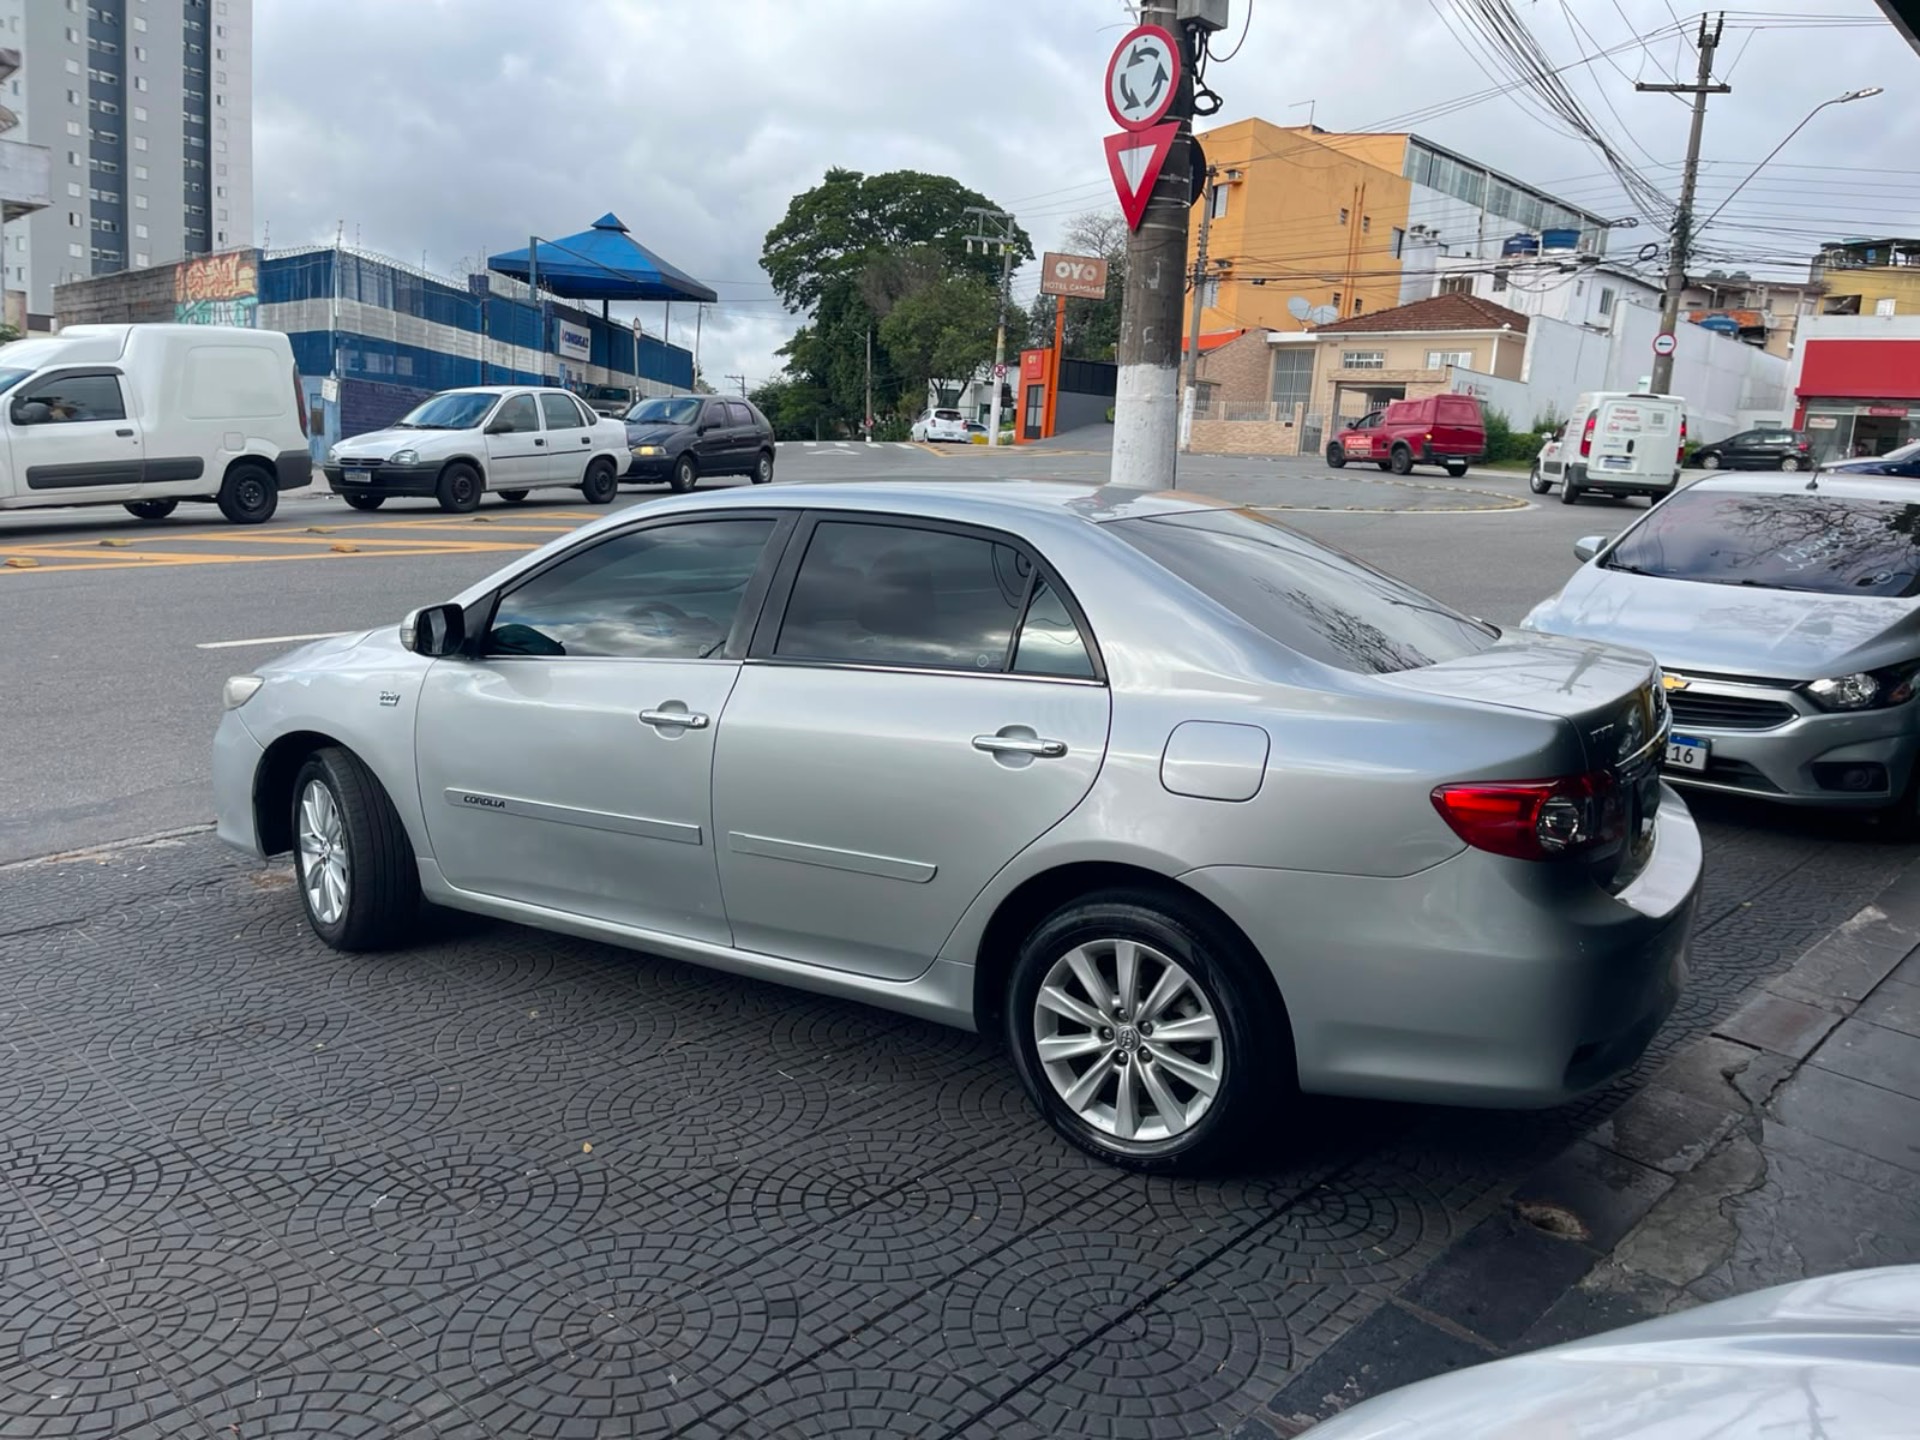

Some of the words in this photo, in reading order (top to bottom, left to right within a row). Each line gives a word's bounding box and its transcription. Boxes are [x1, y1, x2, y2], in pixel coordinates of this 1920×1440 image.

[1055, 261, 1097, 280] OYO
[1044, 281, 1068, 290] HOTEL
[1665, 746, 1695, 764] 16
[463, 795, 506, 808] COROLLA
